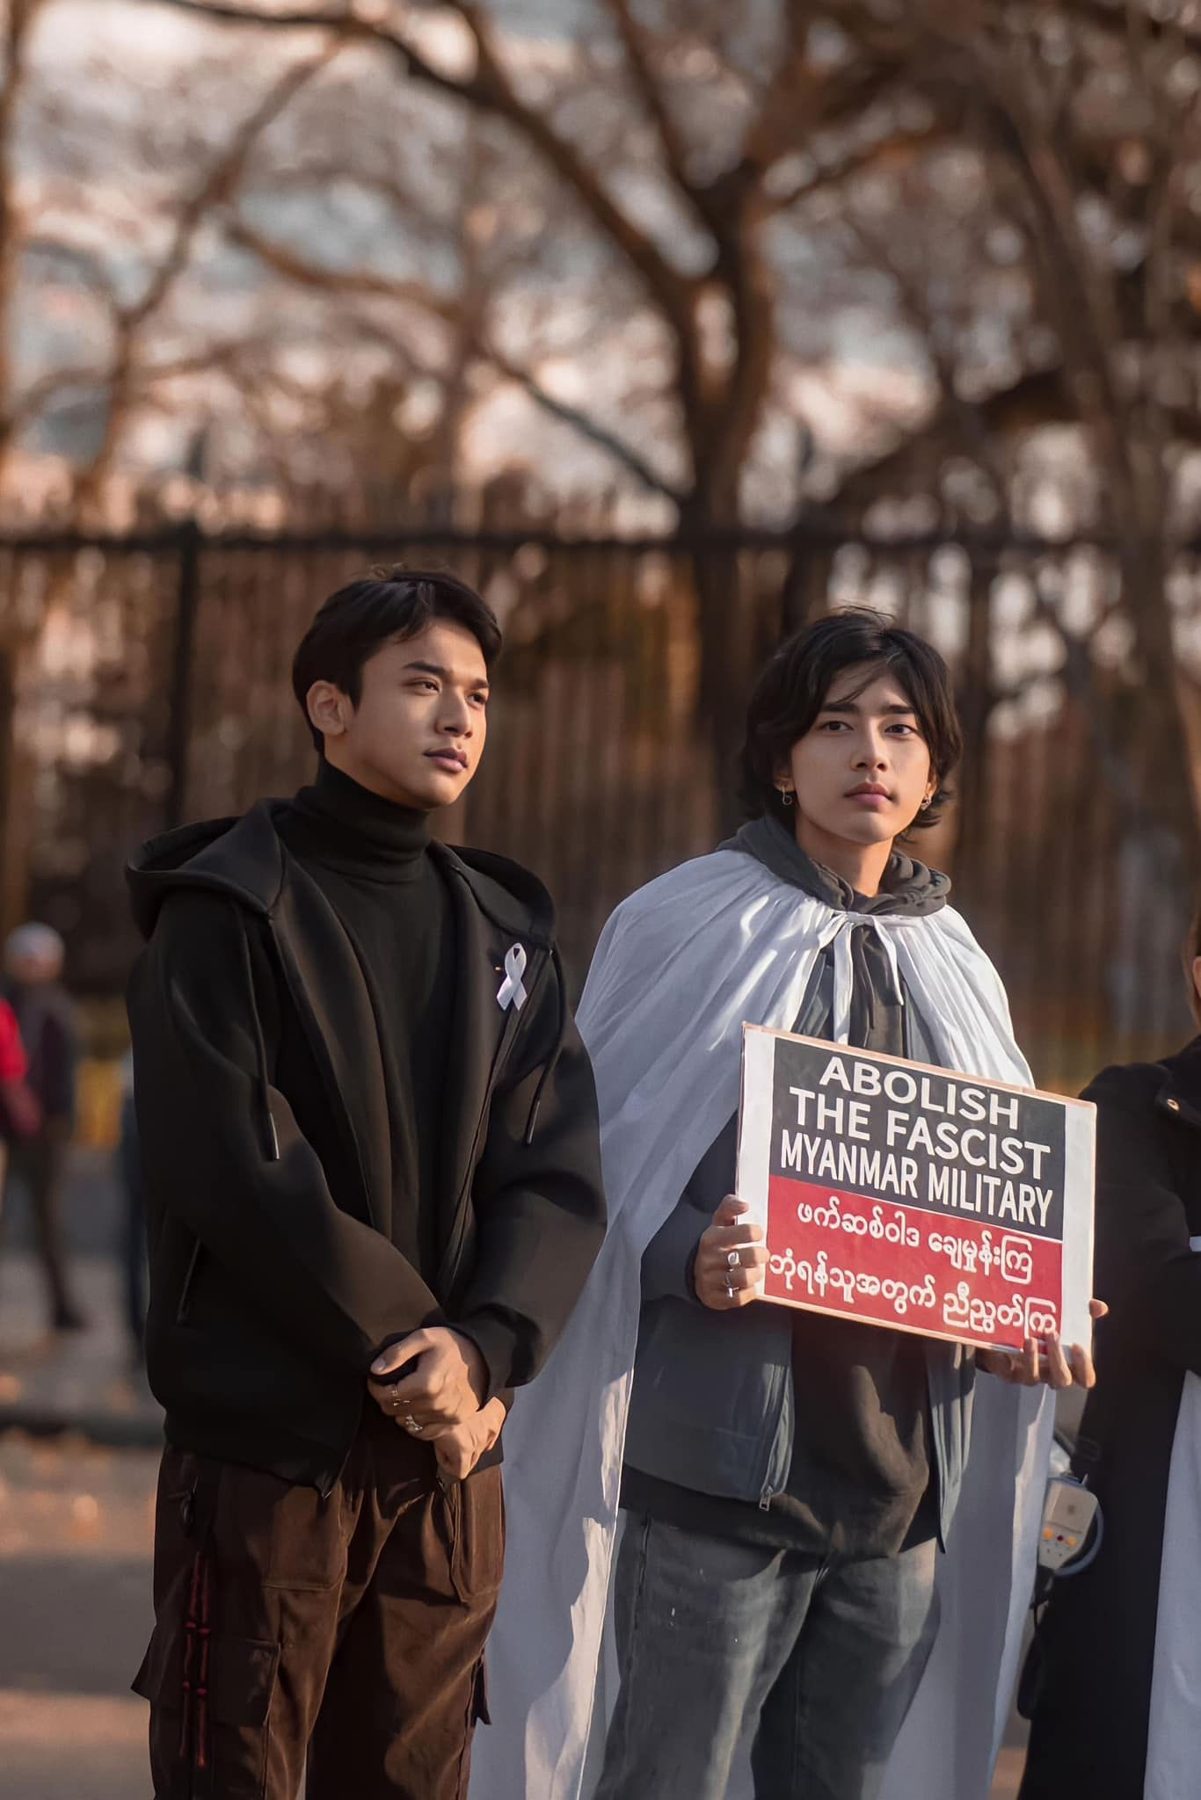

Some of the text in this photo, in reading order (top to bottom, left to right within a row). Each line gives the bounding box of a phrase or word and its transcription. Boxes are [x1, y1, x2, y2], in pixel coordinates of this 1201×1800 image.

[820, 1056, 1018, 1129] ABOLISH
[789, 1087, 1051, 1179] THE FASCIST
[781, 1129, 1052, 1227] MYANMAR MILITARY
[797, 1196, 920, 1247] ဖက်ဆစ်ဝါဒ
[769, 1248, 935, 1314] ဘုံရန်သူအတွက်
